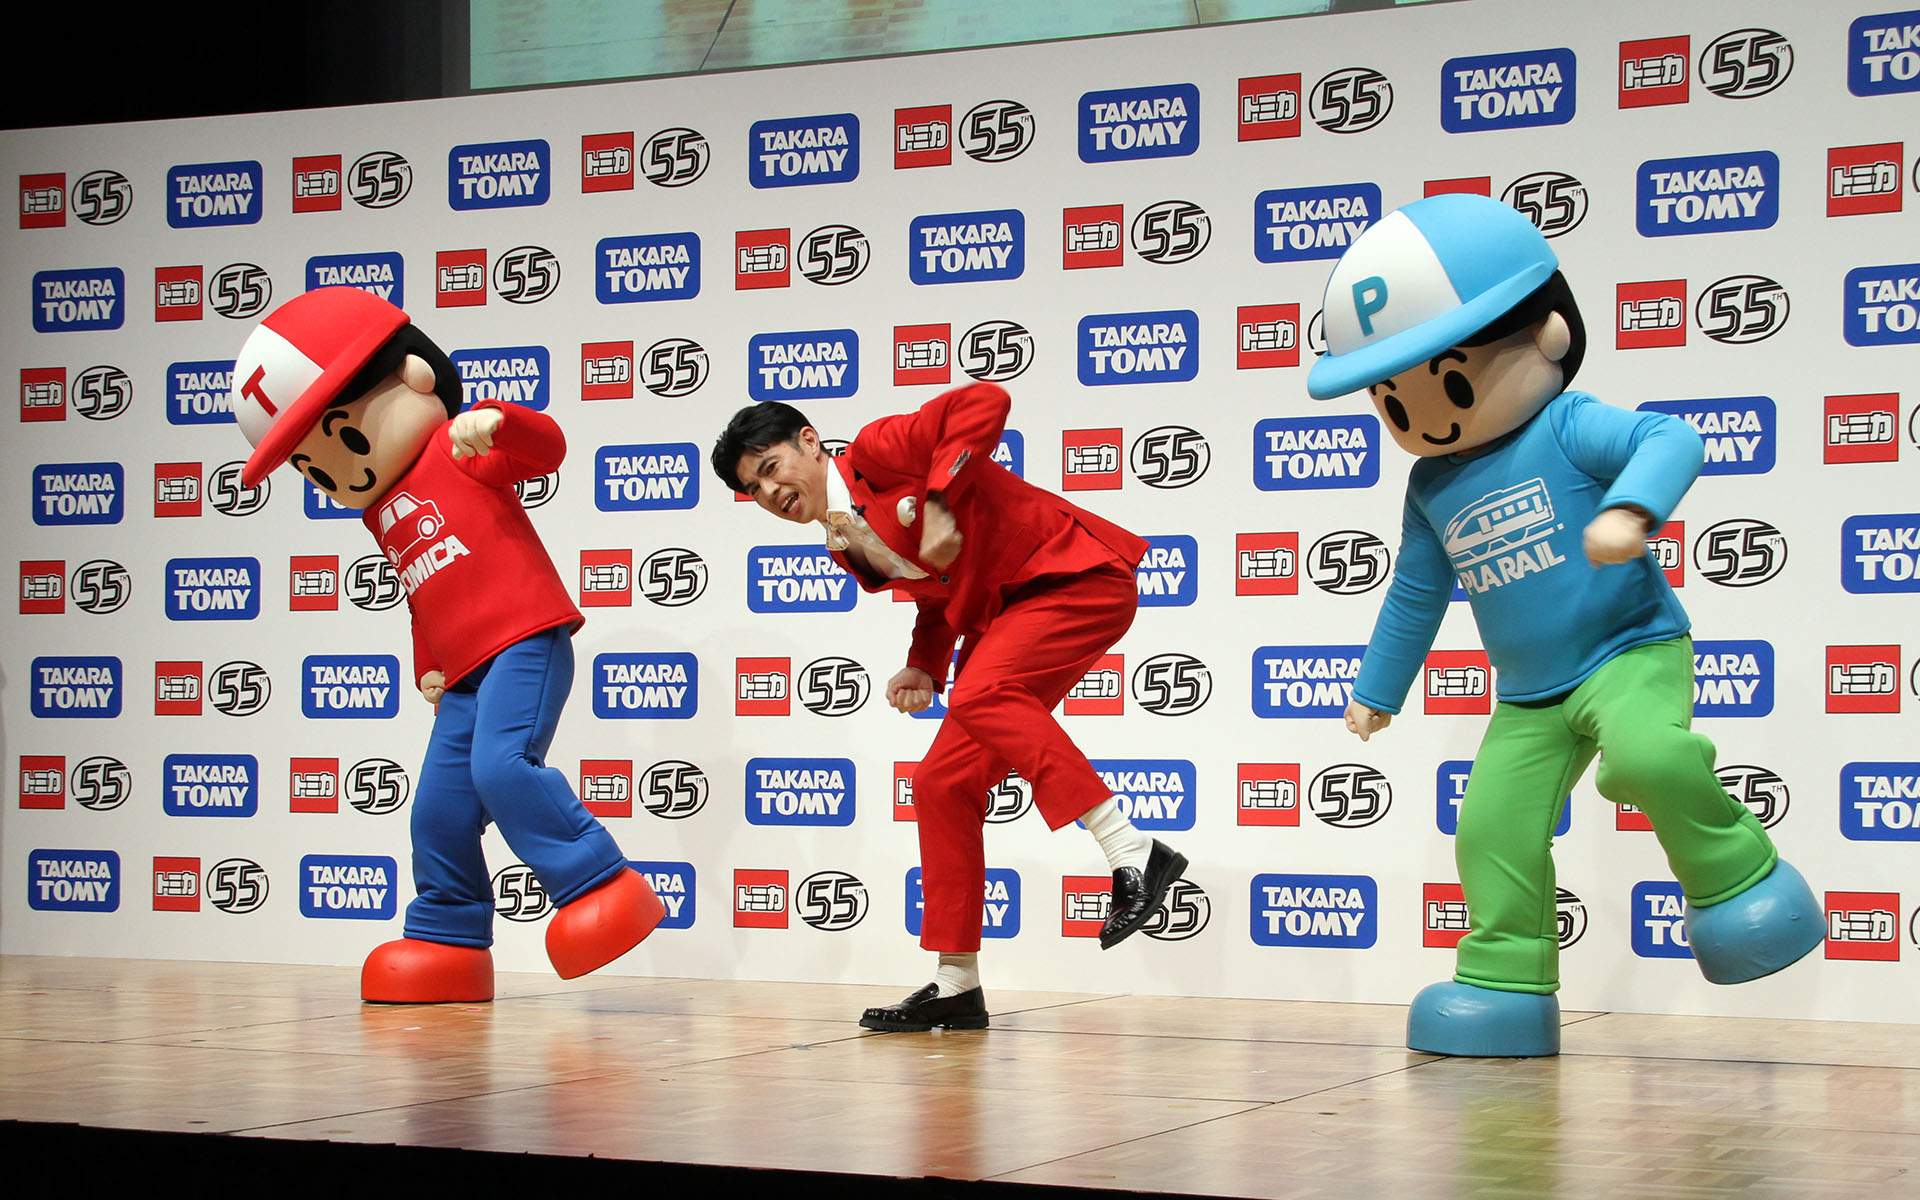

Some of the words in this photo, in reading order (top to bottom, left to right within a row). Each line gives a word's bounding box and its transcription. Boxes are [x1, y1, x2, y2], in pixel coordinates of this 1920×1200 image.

[1863, 25, 1920, 52] TAK
[1454, 62, 1563, 92] TAKARA
[1622, 53, 1686, 91] トミカ
[1862, 51, 1920, 82] TO
[1090, 96, 1188, 124] TAKARA
[1242, 90, 1298, 125] トミカ
[1454, 86, 1563, 120] TOMY
[760, 126, 849, 152] TAKARA
[898, 120, 948, 153] トミカ
[1090, 120, 1188, 150] TOMY
[458, 152, 540, 175] TAKARA
[585, 147, 631, 178] トミカ
[759, 148, 848, 176] TOMY
[176, 172, 253, 194] TAKARA
[296, 169, 338, 198] トミカ
[458, 173, 540, 199] TOMY
[1650, 165, 1766, 195] TAKARA
[1831, 160, 1900, 199] トミカ
[22, 188, 63, 214] トミカ
[176, 193, 253, 217] TOMY
[1266, 196, 1369, 223] TAKARA
[1649, 190, 1766, 224] TOMY
[920, 222, 1013, 247] TAKARA
[1067, 220, 1120, 253] トミカ
[605, 244, 690, 268] TAKARA
[739, 243, 787, 274] トミカ
[920, 244, 1014, 273] TOMY
[314, 264, 394, 285] TAKARA
[440, 263, 483, 293] トミカ
[605, 266, 690, 293] TOMY
[41, 279, 115, 299] TAKARA
[159, 279, 199, 307] トミカ
[1858, 277, 1920, 303] TAK
[41, 299, 116, 322] TOMY
[1352, 275, 1388, 337] P
[1620, 296, 1683, 332] トミカ
[1858, 303, 1920, 332] TO
[1089, 322, 1187, 347] TAKARA
[1241, 319, 1296, 352] トミカ
[758, 341, 848, 364] TAKARA
[897, 339, 947, 370] トミカ
[1088, 346, 1187, 374] TOMY
[457, 358, 540, 379] TAKARA
[585, 355, 630, 385] トミカ
[758, 364, 848, 390] TOMY
[24, 381, 63, 408] トミカ
[175, 392, 234, 414] TOM
[241, 364, 278, 418] T
[462, 379, 540, 403] TOMY
[1676, 411, 1762, 434] KARA
[1828, 410, 1896, 446] トミカ
[1265, 427, 1368, 452] TAKARA
[1703, 436, 1762, 463] MY
[604, 454, 690, 476] TAKARA
[1066, 443, 1119, 475] トミカ
[1265, 451, 1368, 479] TOMY
[41, 473, 115, 492] TAKARA
[158, 476, 198, 503] トミカ
[604, 476, 689, 501] TOMY
[41, 493, 115, 516] TOMY
[400, 534, 471, 596] OMICA
[757, 556, 847, 577] TAKARA
[1137, 548, 1186, 568] ARA
[1239, 547, 1295, 579] トミカ
[1459, 541, 1566, 595] PLARAIL
[1855, 552, 1920, 581] TO
[23, 573, 62, 600] トミカ
[174, 568, 251, 587] TAKARA
[293, 569, 335, 596] トミカ
[349, 561, 400, 606] 55
[583, 563, 629, 592] トミカ
[757, 577, 847, 603] TOMY
[1137, 571, 1186, 595] MY
[173, 588, 251, 611] TOMY
[39, 667, 113, 685] TAKARA
[310, 666, 390, 684] TAKARA
[602, 664, 688, 683] TAKARA
[739, 672, 787, 700] トミカ
[1427, 666, 1487, 698] トミカ
[1830, 662, 1897, 695] トミカ
[39, 687, 113, 709] TOMY
[158, 674, 199, 701] トミカ
[310, 686, 390, 709] TOMY
[602, 685, 687, 709] TOMY
[1694, 679, 1761, 704] MY
[23, 769, 62, 795] トミカ
[172, 765, 249, 783] TAKARA
[293, 771, 335, 799] トミカ
[755, 769, 845, 790] TAKARA
[171, 785, 248, 807] TOMY
[584, 774, 629, 802] トミカ
[1241, 779, 1297, 810] トミカ
[755, 791, 845, 816] TOMY
[1114, 794, 1184, 819] OMY
[1854, 801, 1920, 829] TO
[36, 860, 111, 879] TAKARA
[308, 866, 388, 886] TAKARA
[647, 874, 685, 892] ARA
[36, 880, 111, 902] TOMY
[156, 870, 197, 897] トミカ
[495, 872, 547, 916] 55
[308, 886, 388, 909] TOMY
[737, 884, 785, 913] トミカ
[1262, 886, 1365, 909] TAKARA
[1262, 910, 1365, 936] TOMY
[1427, 901, 1470, 931] トミ
[1828, 909, 1896, 943] トミカ
